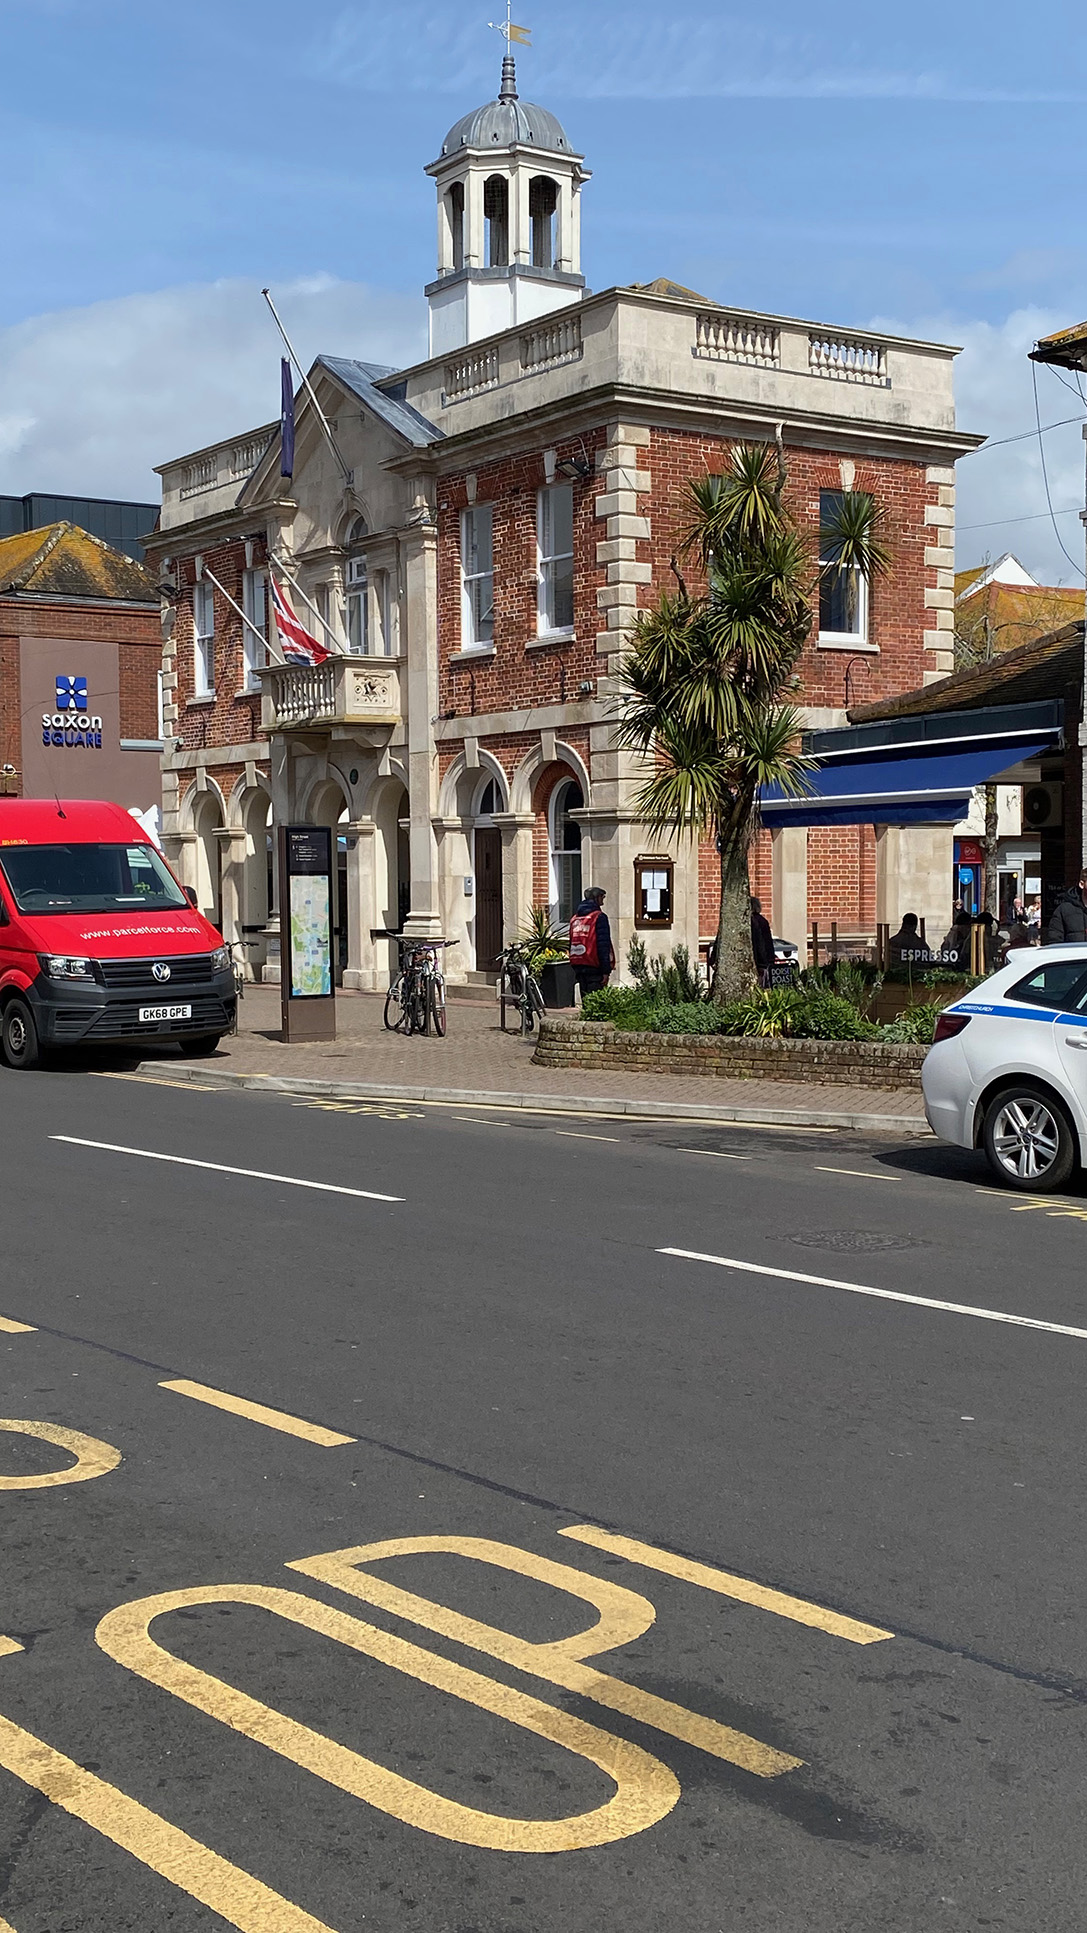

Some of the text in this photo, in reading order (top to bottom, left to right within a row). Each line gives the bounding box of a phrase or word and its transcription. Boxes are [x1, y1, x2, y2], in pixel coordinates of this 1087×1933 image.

[42, 713, 102, 730] saxon
[42, 730, 102, 747] SQUARE
[80, 926, 201, 940] www.parcelforce.com
[900, 948, 959, 962] ESPRESSO
[771, 974, 793, 984] ROAST
[143, 1006, 188, 1019] GK68 GPE
[291, 1100, 426, 1120] TAXIS
